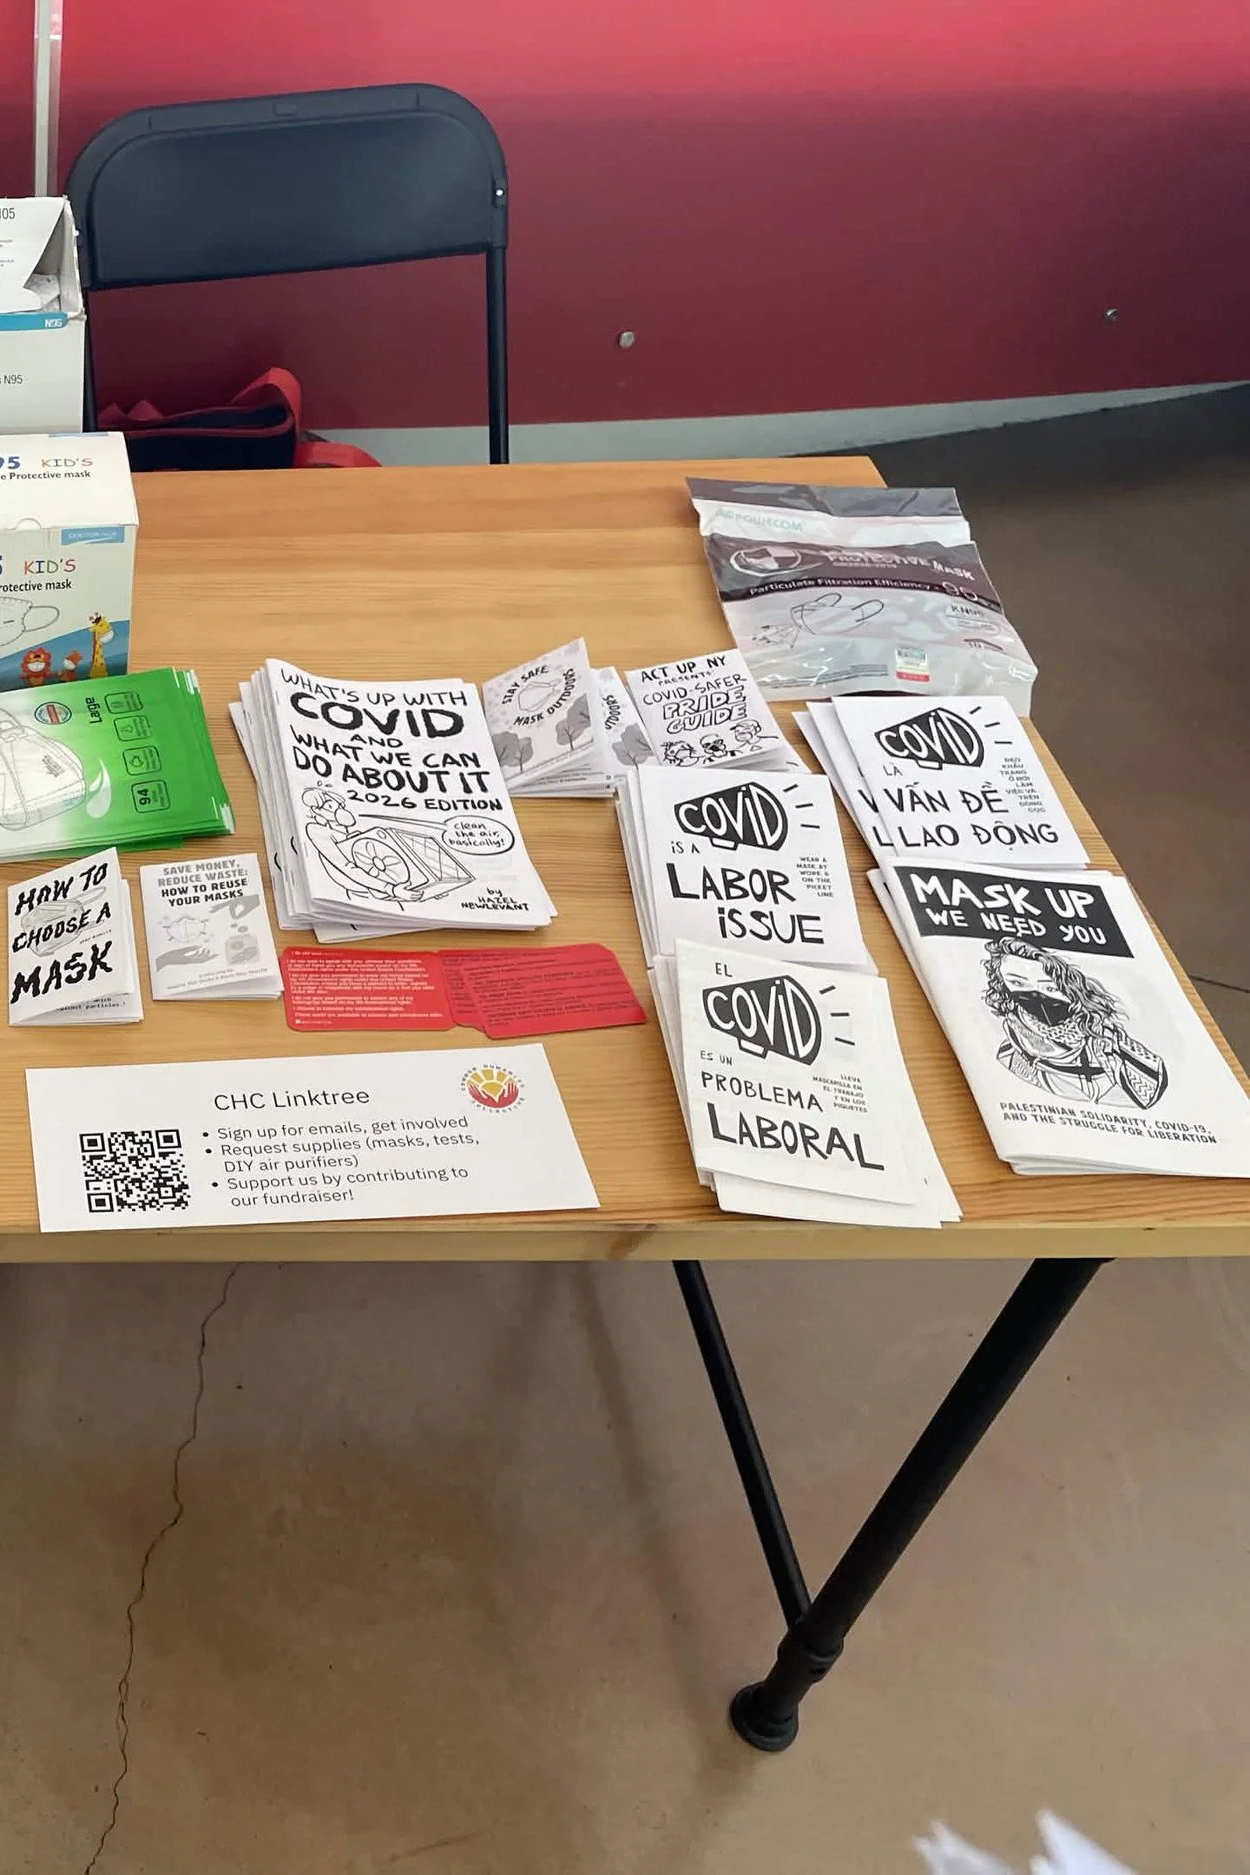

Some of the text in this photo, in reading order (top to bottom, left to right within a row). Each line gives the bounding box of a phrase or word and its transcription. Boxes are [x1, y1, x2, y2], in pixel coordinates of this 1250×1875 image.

[8, 470, 65, 482] Protective
[66, 469, 91, 479] mask
[41, 456, 94, 469] KID'S
[23, 558, 77, 575] KID'S
[44, 579, 72, 590] mask
[817, 577, 931, 591] Filtration Efficiency
[641, 655, 727, 684] ACT UP NY
[280, 668, 469, 707] WHAT'S UP WITH
[502, 664, 550, 705] STAY SAFE
[513, 712, 544, 727] MASK
[546, 667, 576, 716] OUTDOORS
[643, 673, 748, 706] COVID-SAFER
[85, 697, 103, 724] Large
[290, 691, 465, 738] COVID
[662, 685, 746, 720] PRIDE
[666, 703, 748, 734] GUIDE
[290, 724, 482, 769] WHAT WE CAN
[350, 733, 404, 749] AND
[292, 747, 491, 794] DO ABOUT IT
[346, 790, 503, 812] 2026 EDITION
[690, 842, 701, 854] A
[901, 824, 960, 849] LAO
[973, 822, 1060, 851] ĐỘNG
[157, 874, 203, 887] REDUCE
[163, 864, 191, 876] SAVE
[665, 862, 796, 904] LABOR
[14, 863, 108, 916] HOW TO
[161, 878, 248, 898] HOW TO REUSE
[168, 888, 244, 907] YOUR MASKS
[911, 873, 1095, 920] MASK UP
[12, 908, 92, 953] CHOOSE
[96, 902, 112, 924] A
[927, 908, 1107, 946] WE NEED YOU
[10, 940, 113, 1004] MASK
[714, 962, 733, 978] EL
[700, 1049, 733, 1065] ES UN
[213, 1089, 370, 1111] CHC Linktree
[701, 1071, 823, 1112] PROBLEMA
[1000, 1102, 1076, 1117] PALESTINIAN
[217, 1115, 469, 1142] Sign up for emails, get involved
[706, 1102, 885, 1172] LABORAL
[1003, 1112, 1218, 1144] AND THE STRUGGLE FOR LIBERATION
[221, 1132, 480, 1159] Request supplies (masks, tests,
[224, 1154, 359, 1172] DIY air purifiers)
[227, 1166, 469, 1191] Support us by contributing to
[231, 1189, 354, 1207] our fundraiser!
